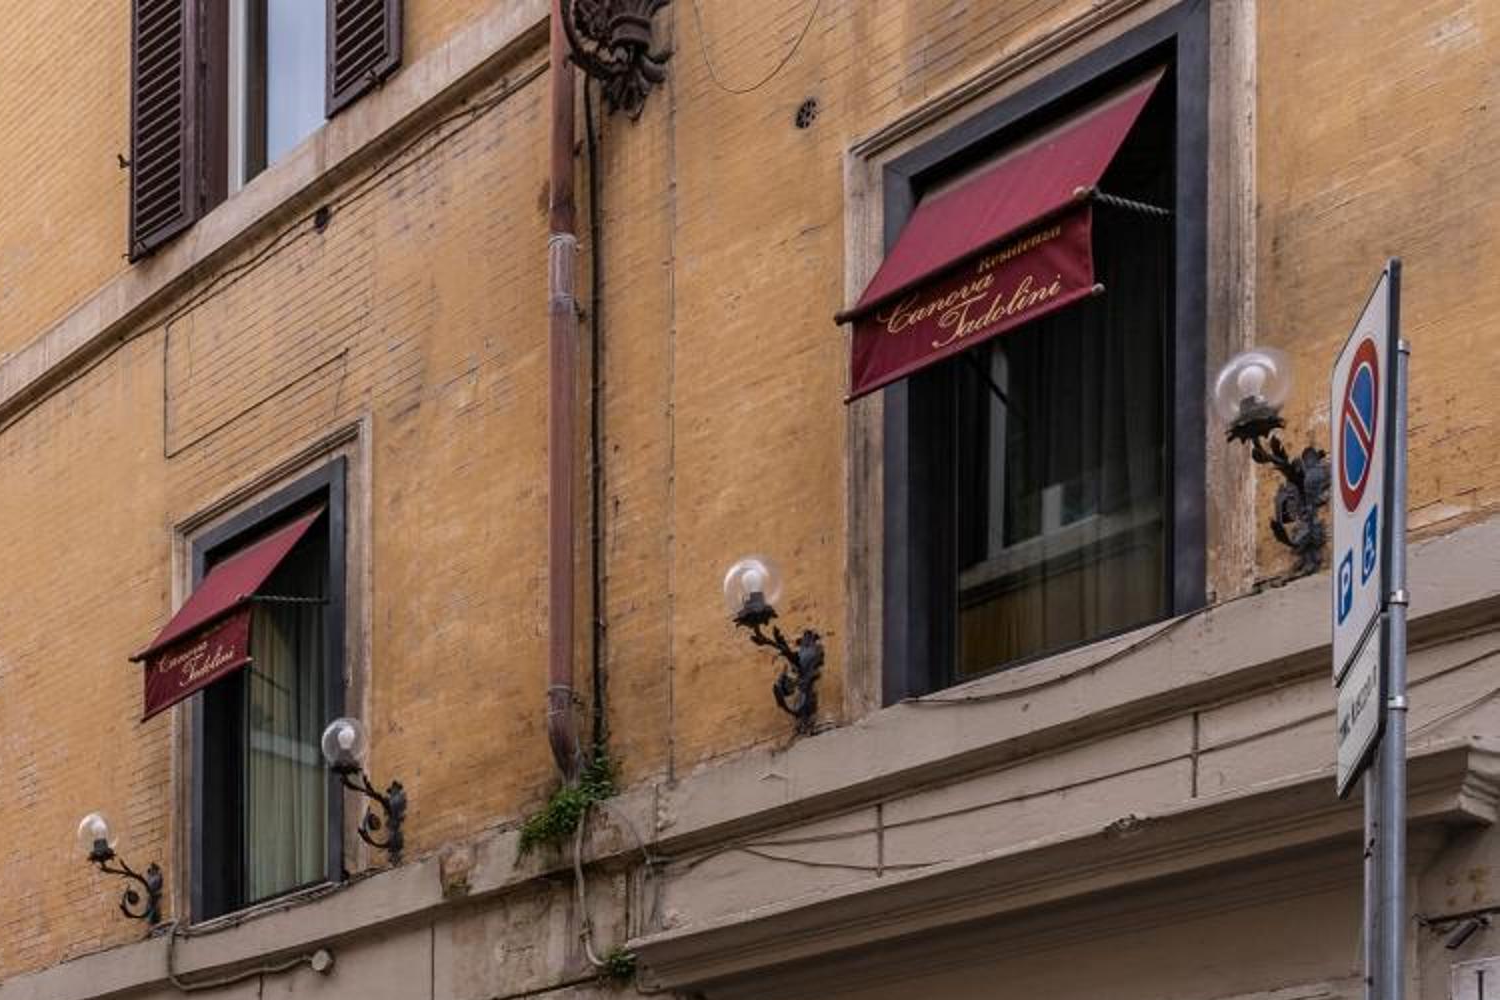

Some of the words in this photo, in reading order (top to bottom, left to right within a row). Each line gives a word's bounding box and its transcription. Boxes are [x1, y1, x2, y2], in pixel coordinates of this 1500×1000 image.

[878, 273, 996, 334] Canova
[932, 273, 1062, 348] Tadolini
[159, 641, 209, 673] Canova
[179, 644, 236, 687] Tadolini
